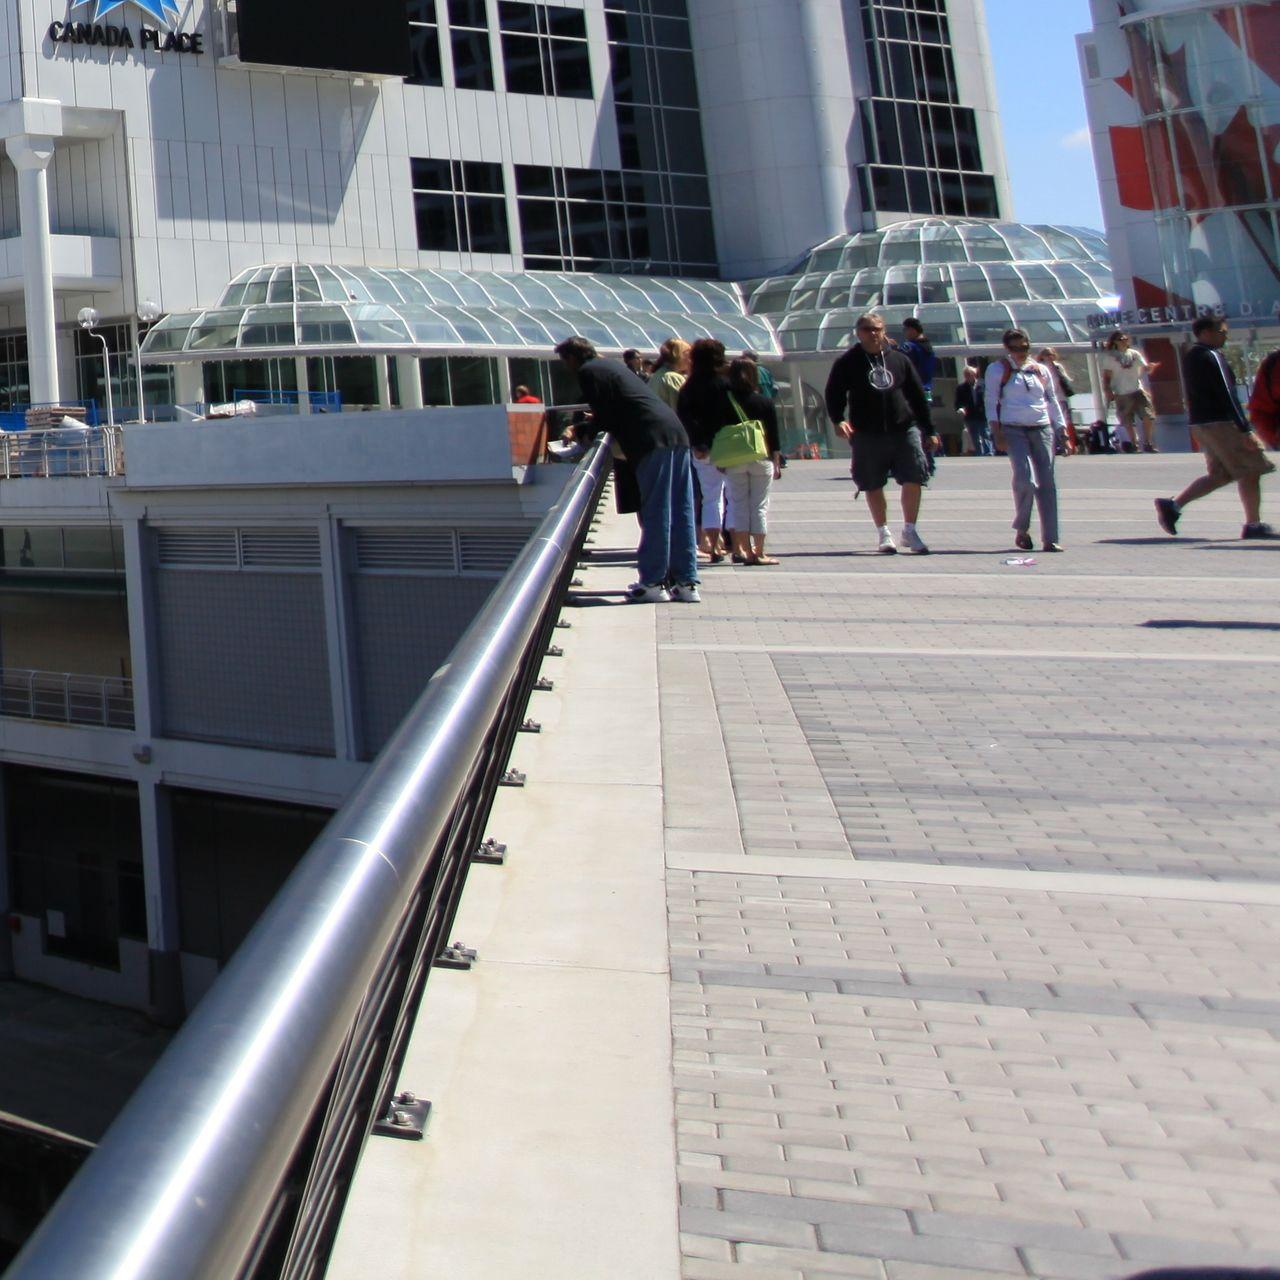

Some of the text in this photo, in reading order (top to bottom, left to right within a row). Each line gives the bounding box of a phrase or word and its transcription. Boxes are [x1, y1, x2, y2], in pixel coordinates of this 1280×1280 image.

[49, 21, 204, 54] CANADA PLACE
[1138, 303, 1225, 322] CENTRE
